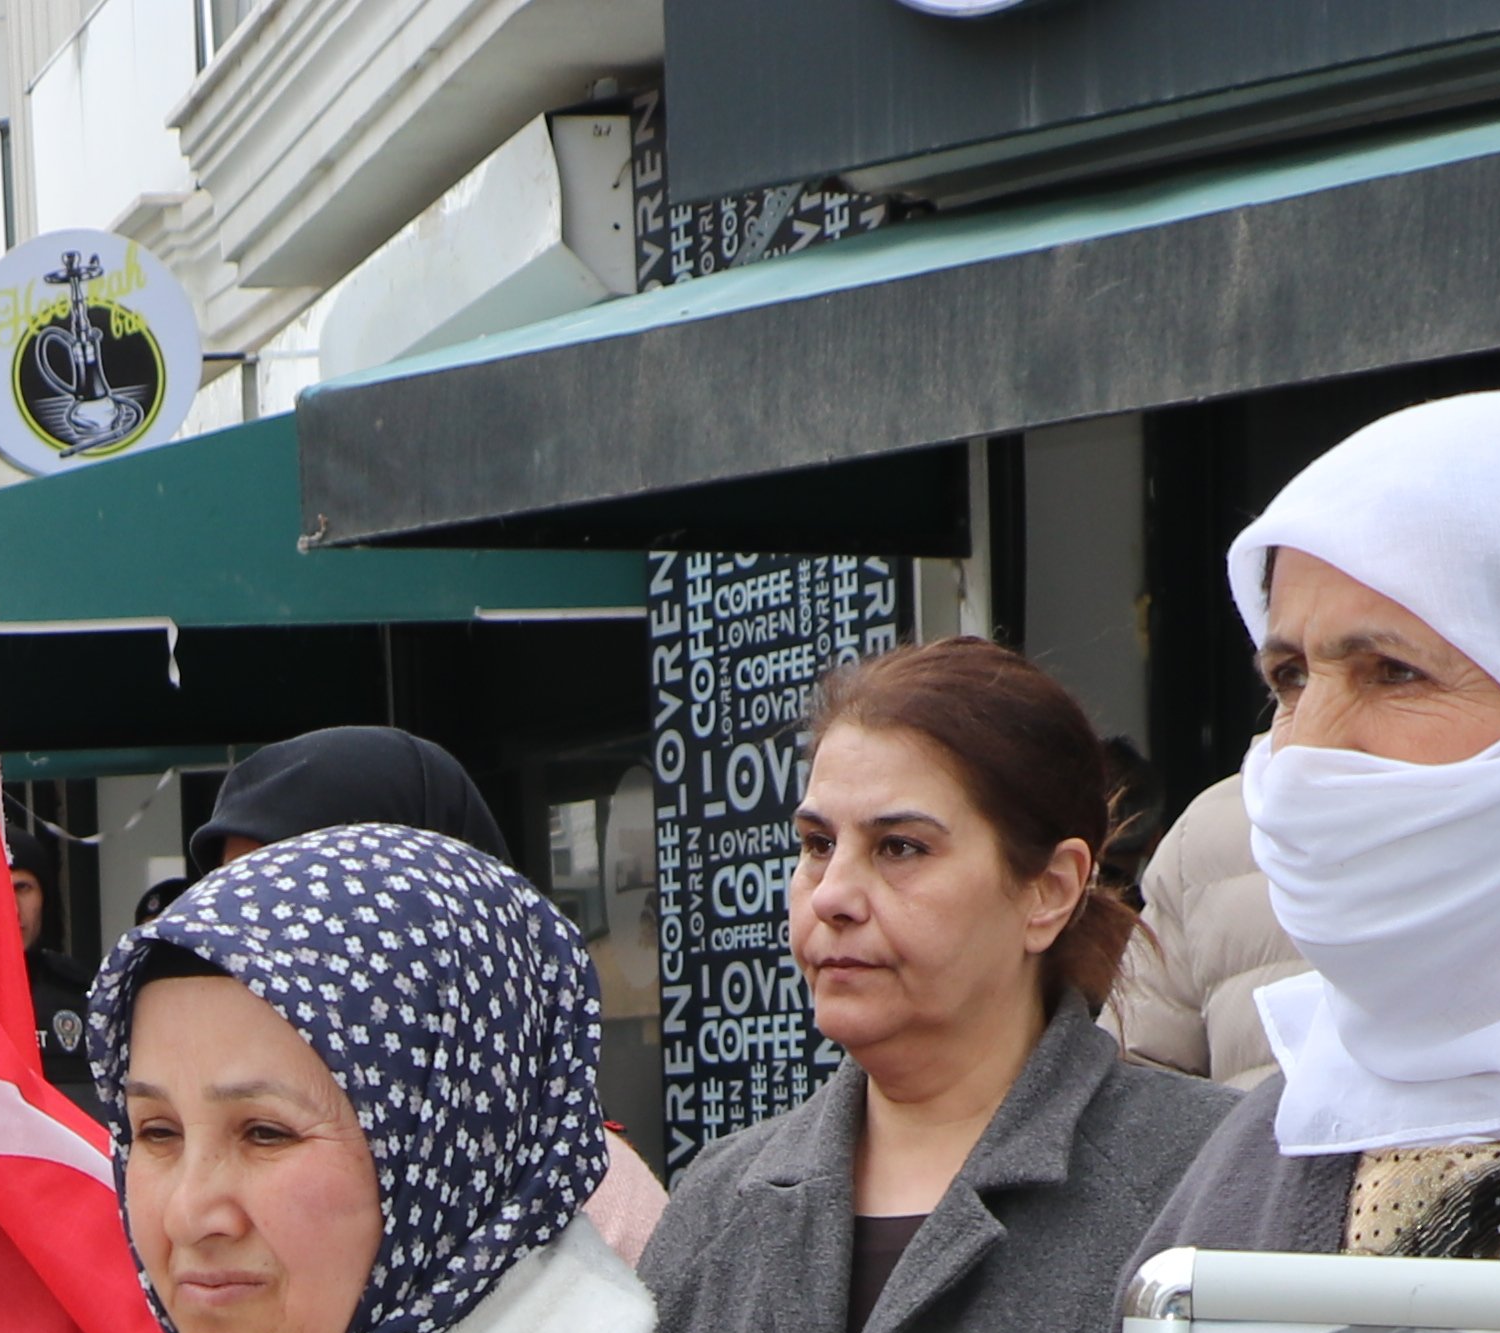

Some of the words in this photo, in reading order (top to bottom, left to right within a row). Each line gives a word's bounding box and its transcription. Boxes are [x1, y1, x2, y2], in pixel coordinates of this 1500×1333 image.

[632, 89, 665, 292] VREN
[714, 569, 794, 618] COFFEE
[719, 608, 796, 652] LOVREN
[799, 558, 812, 637] COFFEE
[833, 555, 860, 667] OFFEE
[649, 552, 688, 819] LOVREN
[686, 552, 716, 738] COFFEE
[736, 643, 817, 691] COFFEE
[719, 656, 734, 747] LOVREN
[702, 731, 812, 818] LOV
[709, 821, 789, 862] LOVREN
[658, 822, 683, 981] COFFEE
[687, 826, 705, 954] LOVREN
[711, 856, 800, 918] COFF
[711, 922, 767, 951] COFFEE
[702, 955, 815, 1019] LOVR
[699, 1012, 807, 1064] COFFEE
[663, 985, 697, 1192] VREN
